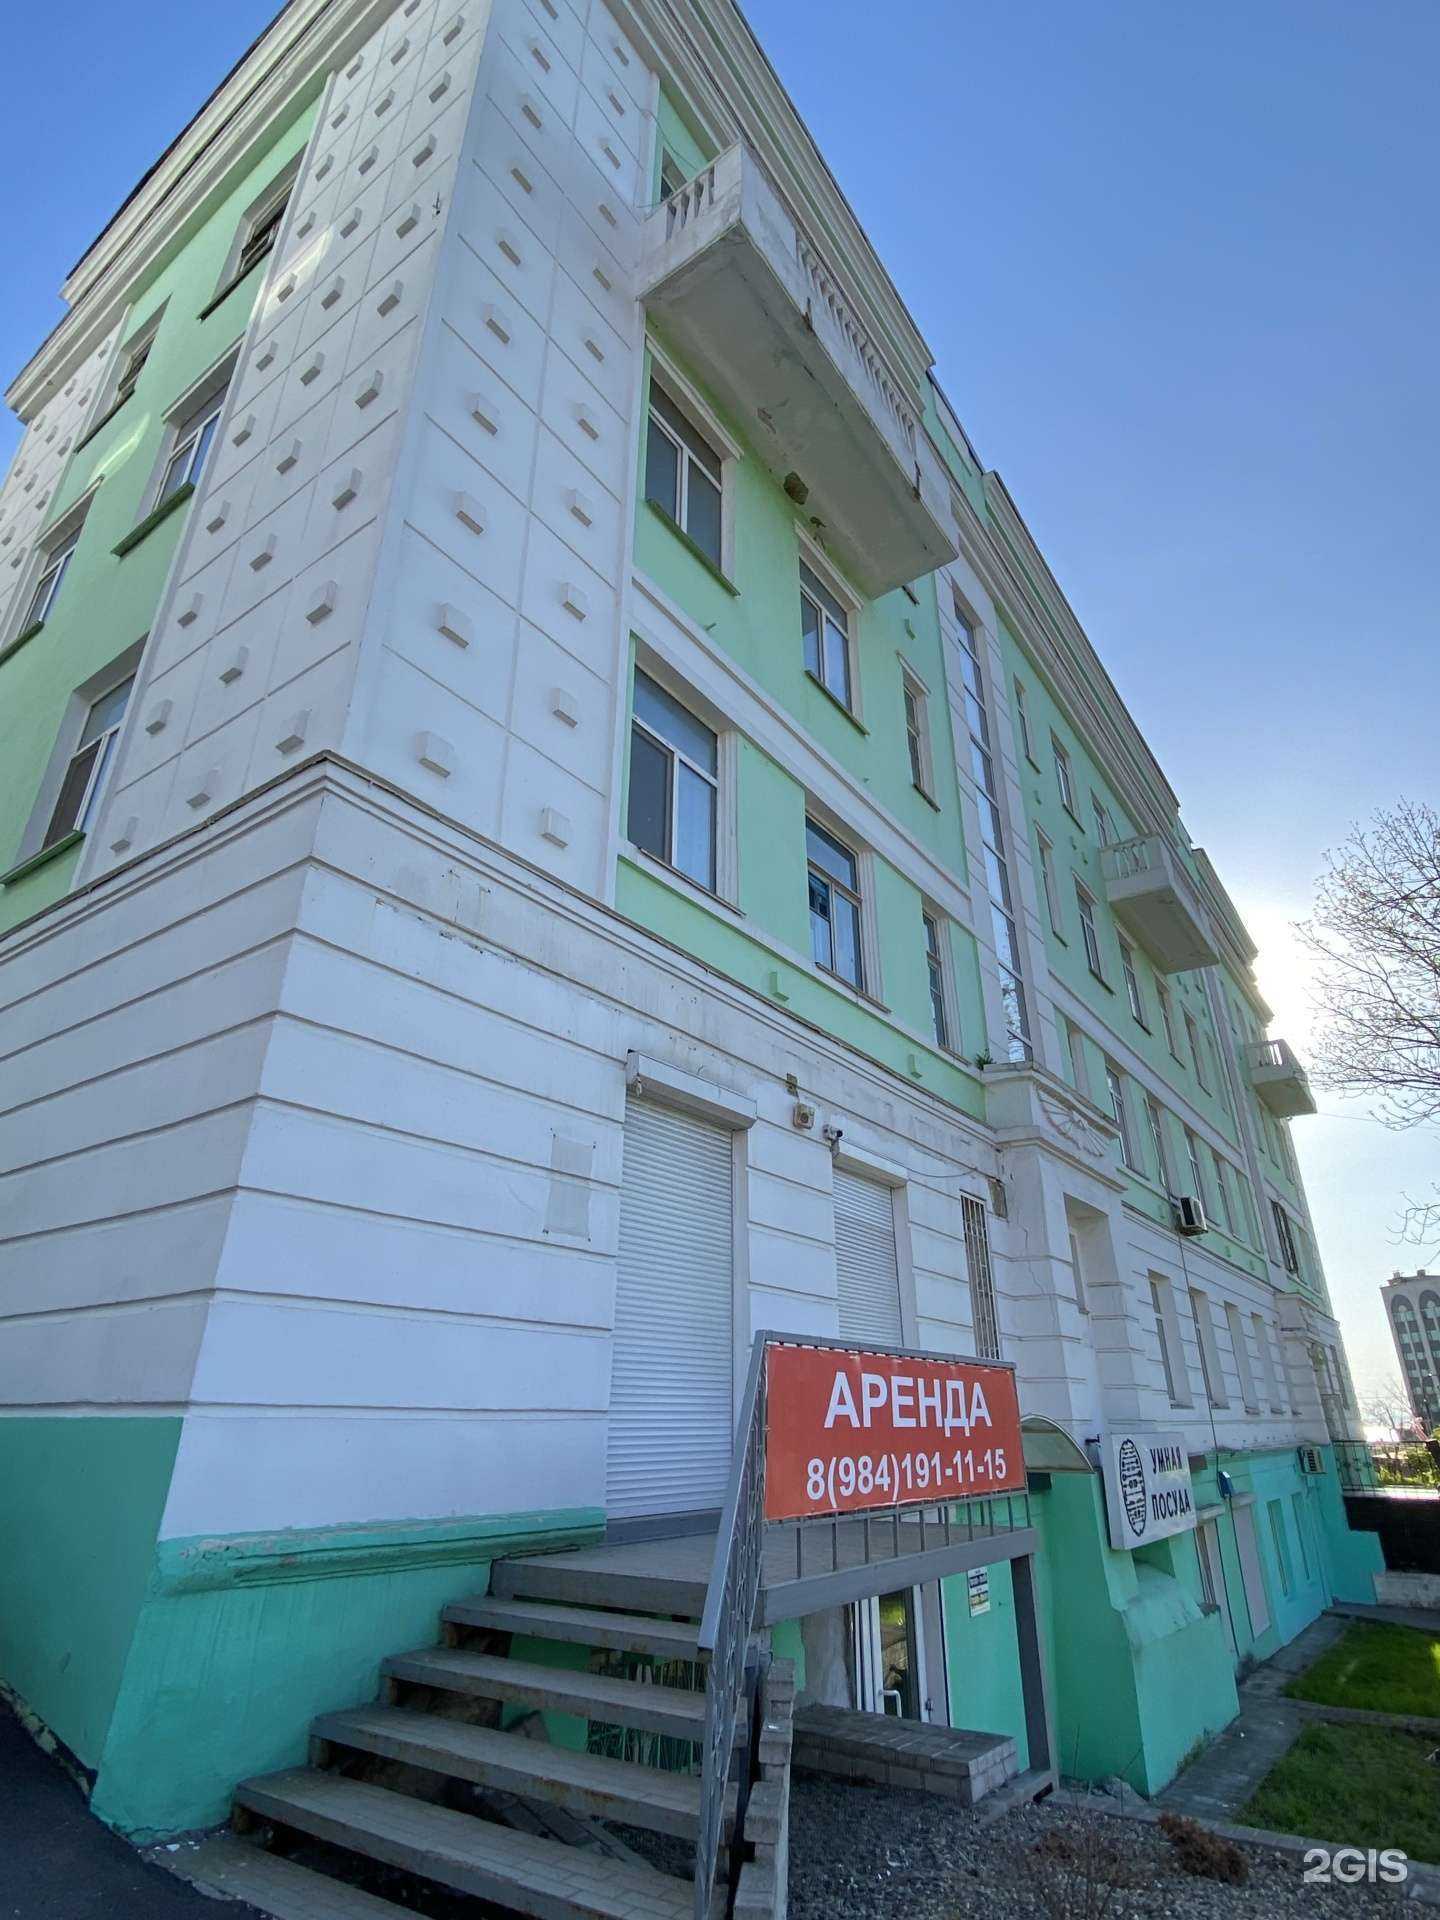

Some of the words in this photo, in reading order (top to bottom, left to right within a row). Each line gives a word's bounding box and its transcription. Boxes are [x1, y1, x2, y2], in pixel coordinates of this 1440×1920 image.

[823, 1371, 993, 1437] АРЕНДА
[806, 1448, 1007, 1508] 8(984)191-11-15
[1150, 1446, 1183, 1474] УМНАЯ
[1151, 1489, 1191, 1521] ПОСУДА
